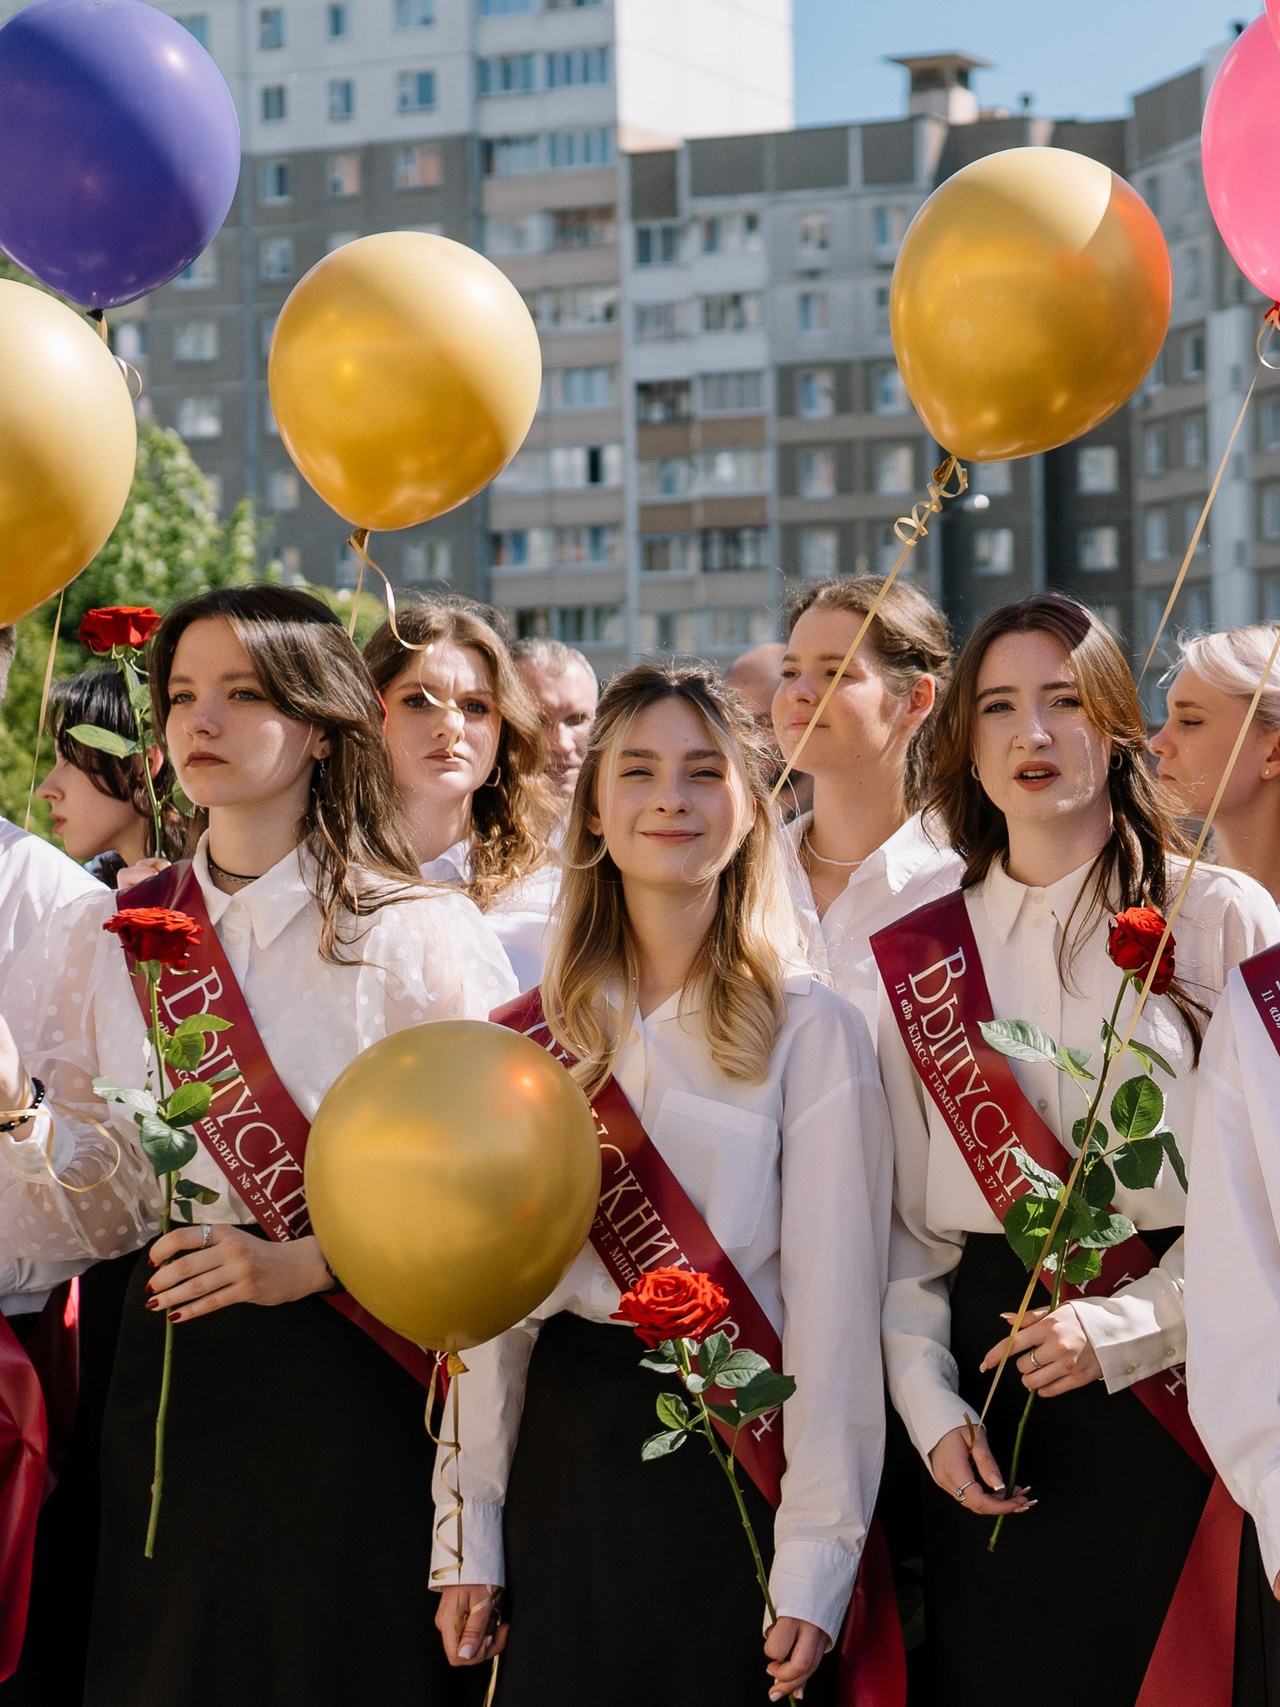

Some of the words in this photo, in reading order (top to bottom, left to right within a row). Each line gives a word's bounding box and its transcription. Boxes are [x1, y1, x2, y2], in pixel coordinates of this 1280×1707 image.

[894, 981, 907, 996] 11
[1260, 989, 1273, 1002] 11
[900, 998, 914, 1021] «В»
[907, 1021, 931, 1068] КЛАСС
[908, 947, 1034, 1202] ВЫПУСК
[928, 1072, 976, 1152] ГИМНАЗИЯ
[973, 1154, 986, 1173] №
[237, 1171, 252, 1190] №
[250, 1190, 264, 1207] 37
[984, 1175, 998, 1190] 37
[993, 1192, 1007, 1208] Г.
[608, 1246, 639, 1289] МИНС
